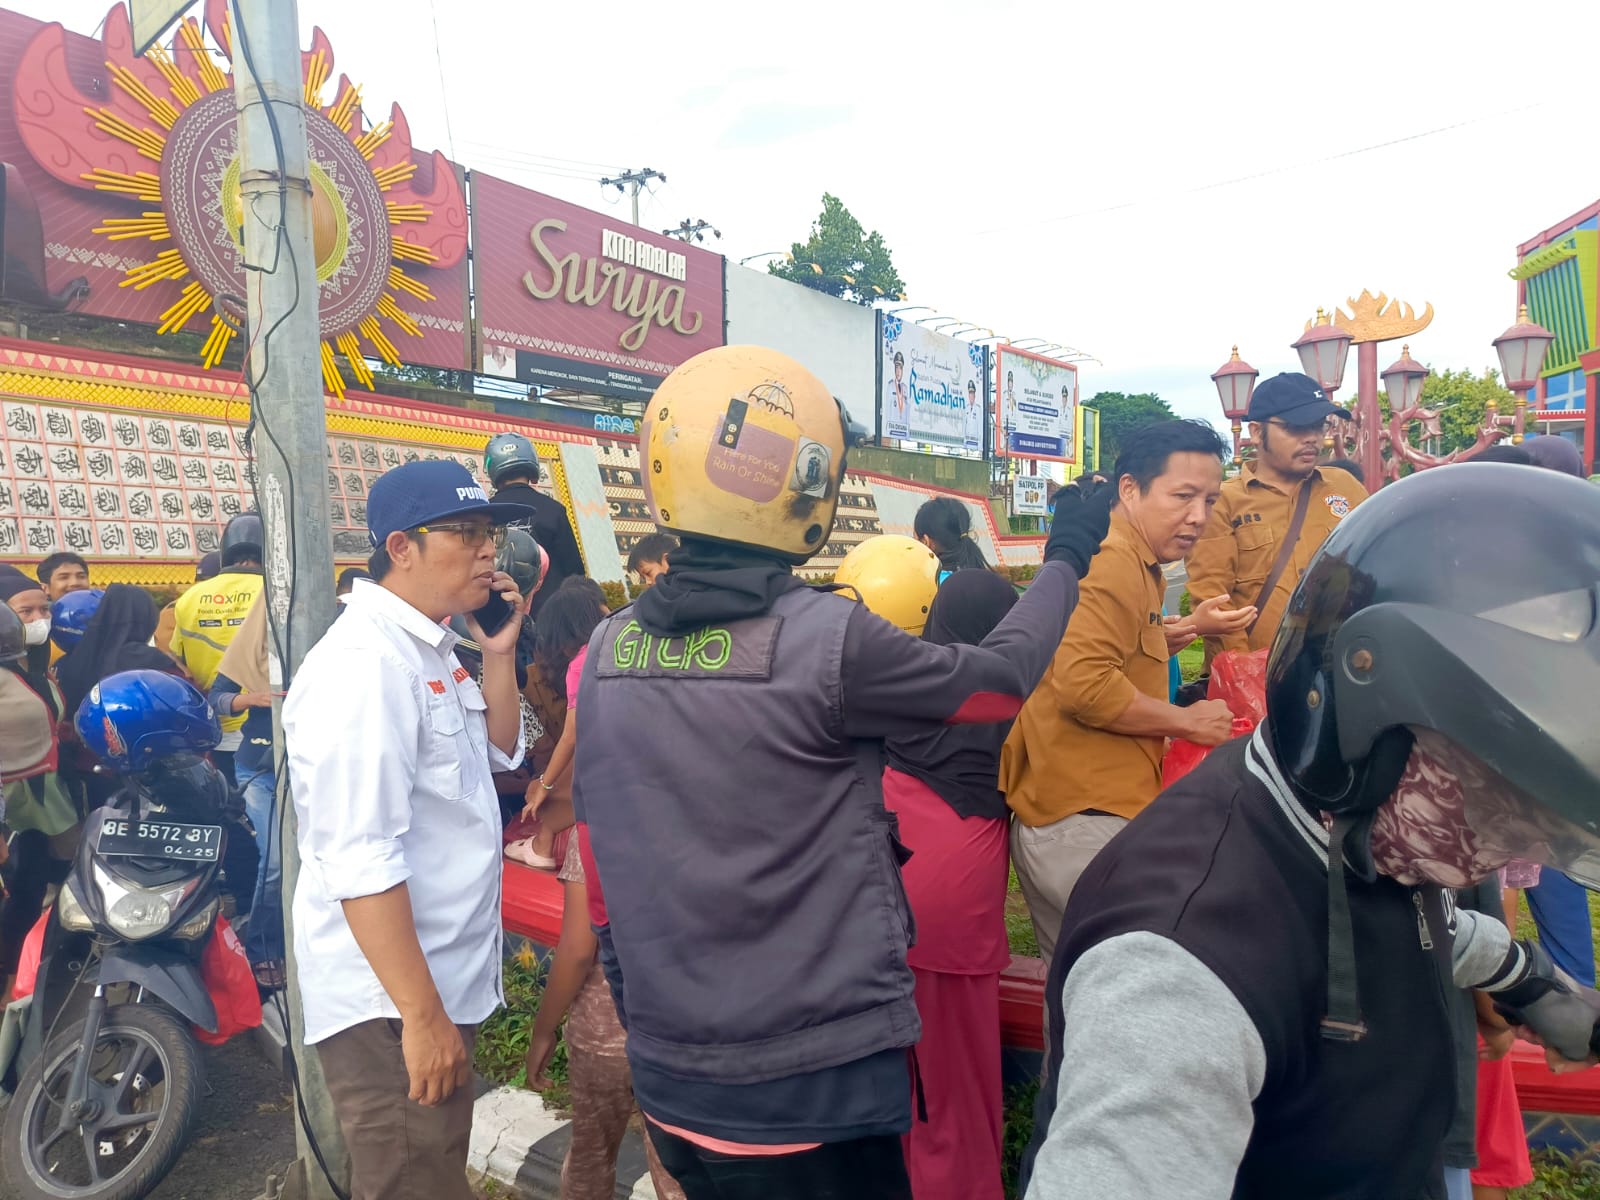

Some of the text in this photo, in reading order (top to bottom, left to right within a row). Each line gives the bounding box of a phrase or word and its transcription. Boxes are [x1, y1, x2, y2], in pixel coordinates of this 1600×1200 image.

[602, 228, 686, 281] KITA ADALAH
[522, 218, 703, 351] Surya
[909, 367, 965, 410] Ramadhan
[200, 590, 251, 605] maxim
[103, 821, 129, 837] BE
[138, 823, 181, 842] 5572
